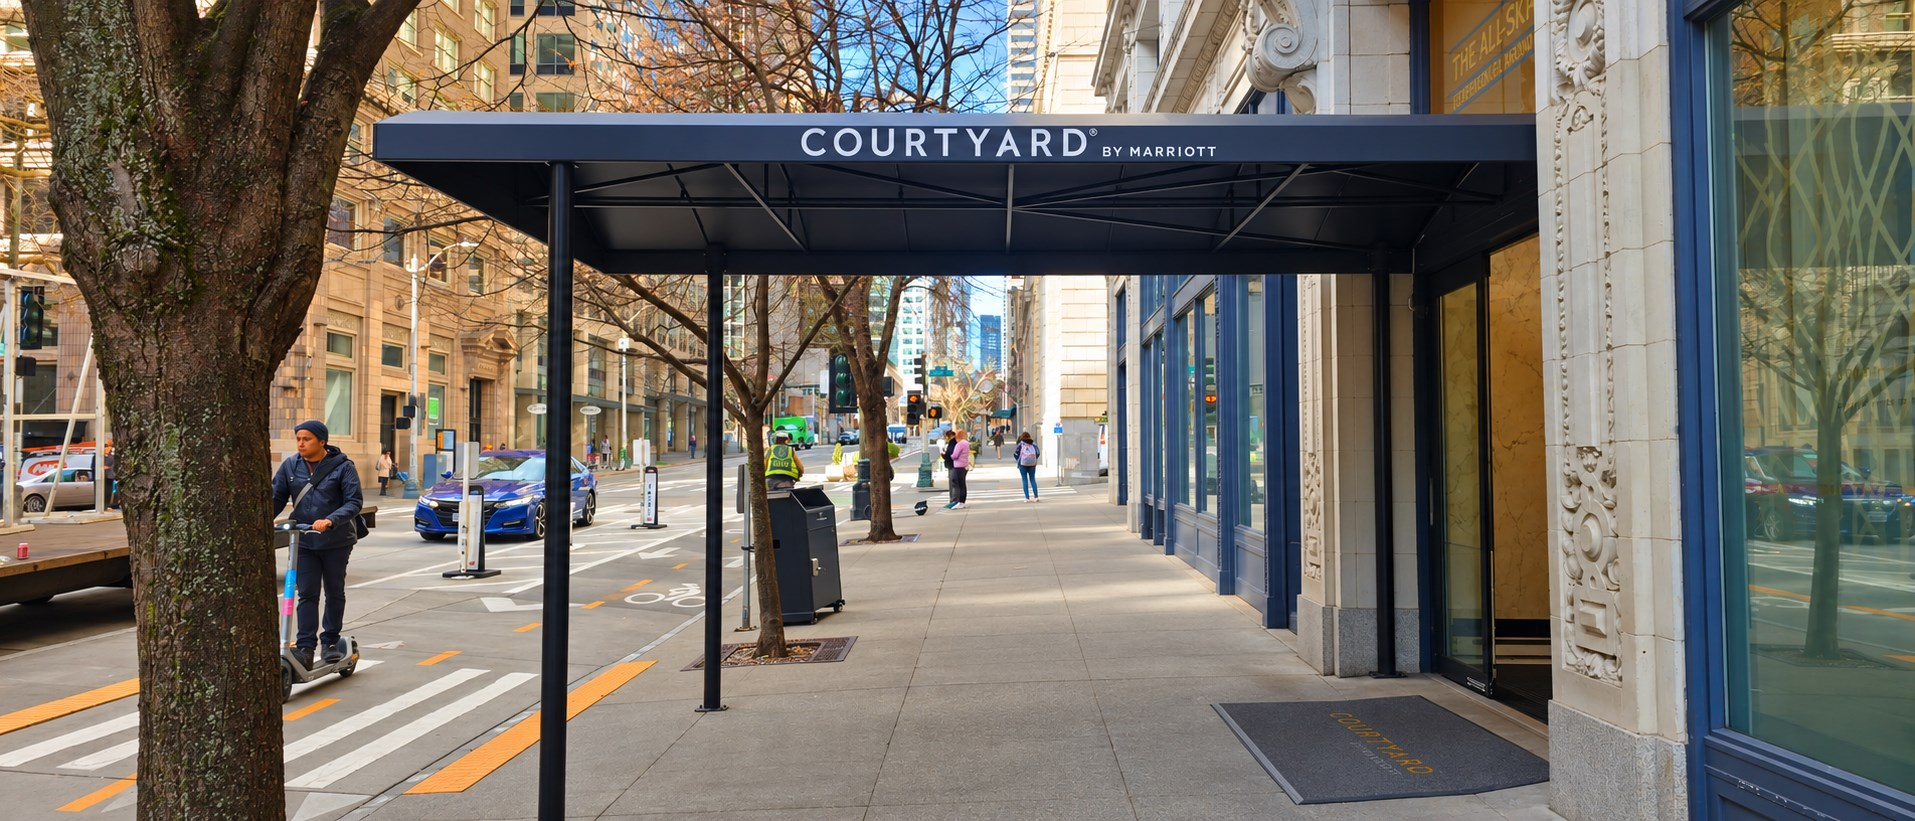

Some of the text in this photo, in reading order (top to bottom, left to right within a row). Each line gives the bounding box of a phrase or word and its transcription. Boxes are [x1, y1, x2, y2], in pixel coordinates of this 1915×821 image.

[1452, 40, 1477, 81] THE
[1102, 146, 1122, 157] BY
[1129, 146, 1216, 157] MARRIOTT
[1328, 711, 1434, 774] COURTYARD
